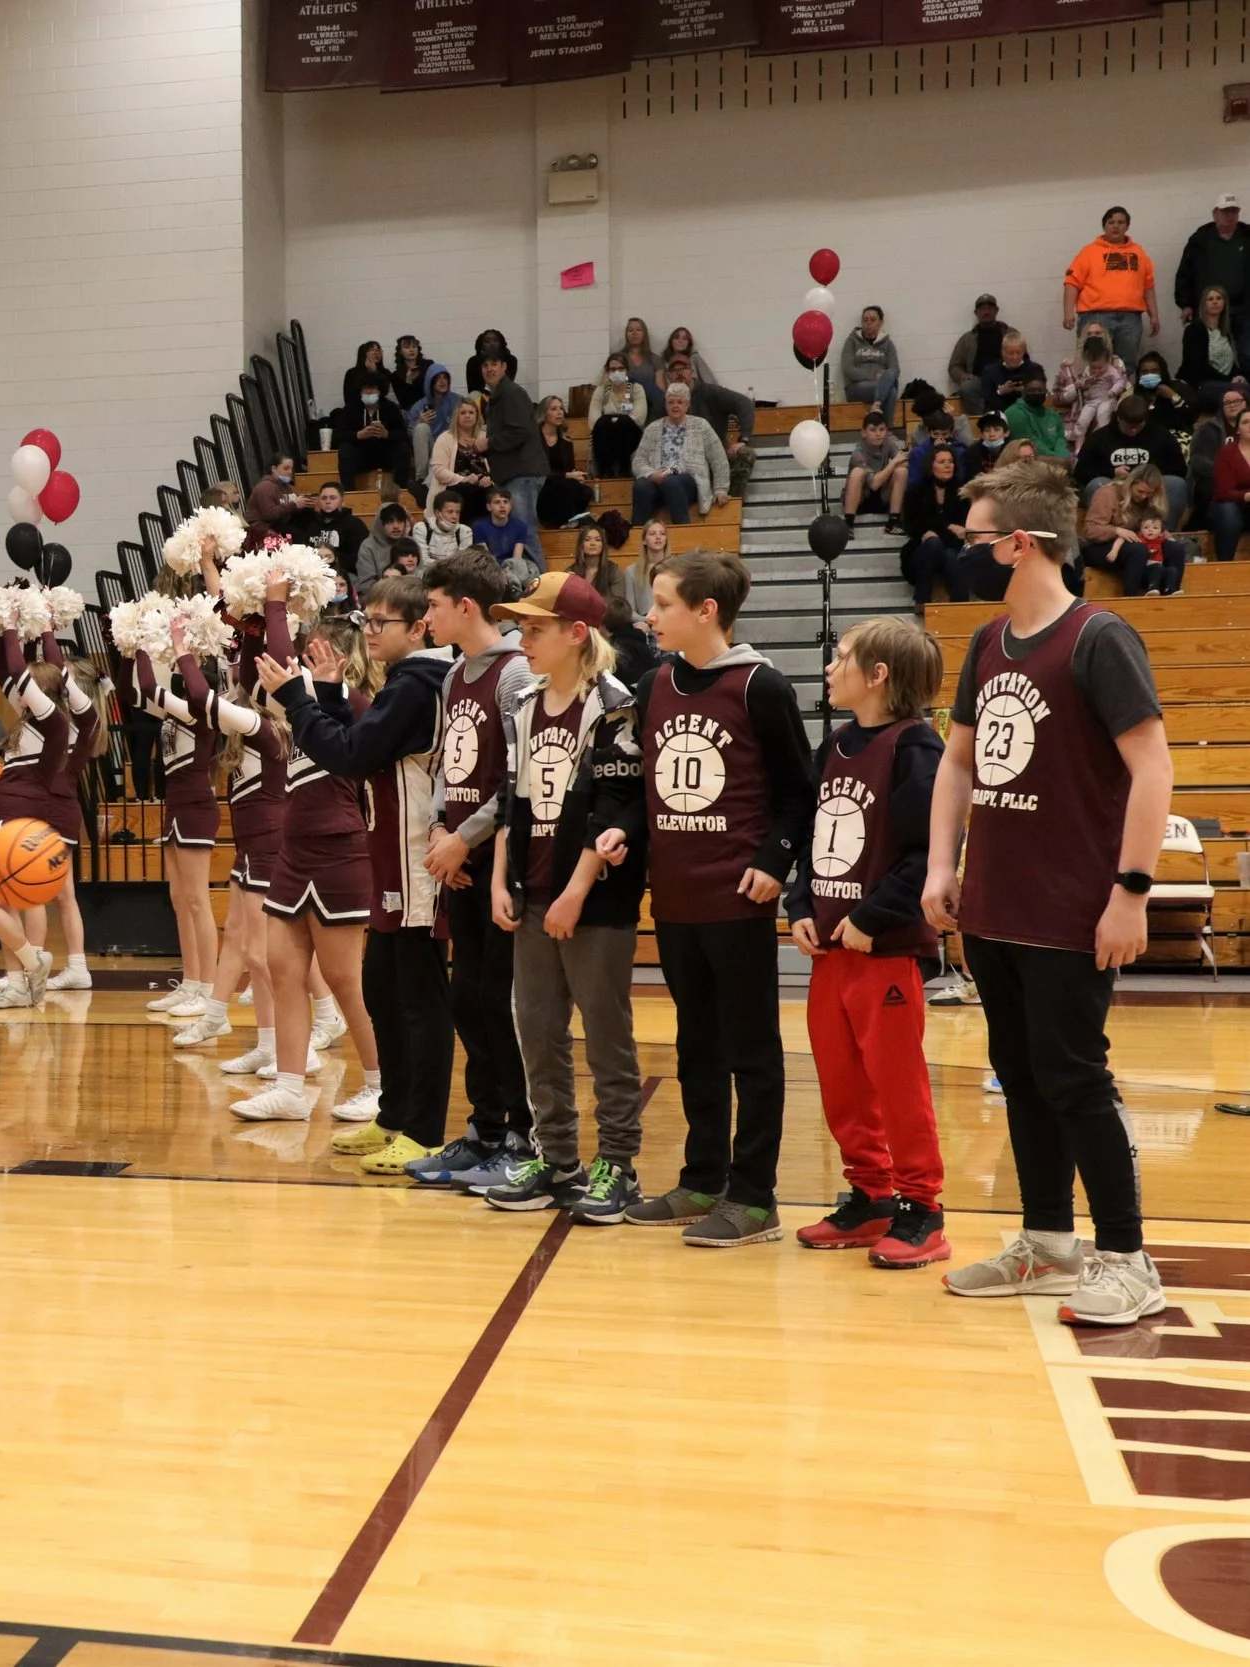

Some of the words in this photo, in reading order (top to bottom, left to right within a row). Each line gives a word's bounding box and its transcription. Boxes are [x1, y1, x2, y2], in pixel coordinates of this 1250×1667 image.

[299, 2, 358, 16] ATHLETICS
[796, 4, 823, 12] HEAVY
[922, 3, 944, 11] JESSE
[925, 8, 959, 16] RICHARD
[791, 11, 813, 19] JOHN
[949, 11, 983, 20] LOVEJOY
[412, 30, 433, 38] STATE
[434, 25, 478, 35] CHAMPIONS
[528, 25, 555, 35] STATE
[556, 20, 604, 31] CHAMPION
[791, 26, 819, 35] JAMES
[820, 23, 845, 33] LEWIS
[319, 30, 358, 39] WRESTLING
[451, 32, 474, 40] TRACK
[539, 31, 568, 41] MEN'S
[569, 30, 593, 39] GOLF
[310, 38, 345, 46] CHAMPION
[530, 48, 556, 58] JERRY
[558, 42, 603, 55] STAFFORD
[654, 714, 733, 749] ACCENT
[984, 720, 1014, 760] 23
[453, 735, 464, 764] 5
[672, 756, 702, 790] 10
[541, 767, 555, 798] 5
[1000, 791, 1039, 811] PLLC
[657, 813, 728, 832] ELEVATOR
[827, 819, 838, 854] 1
